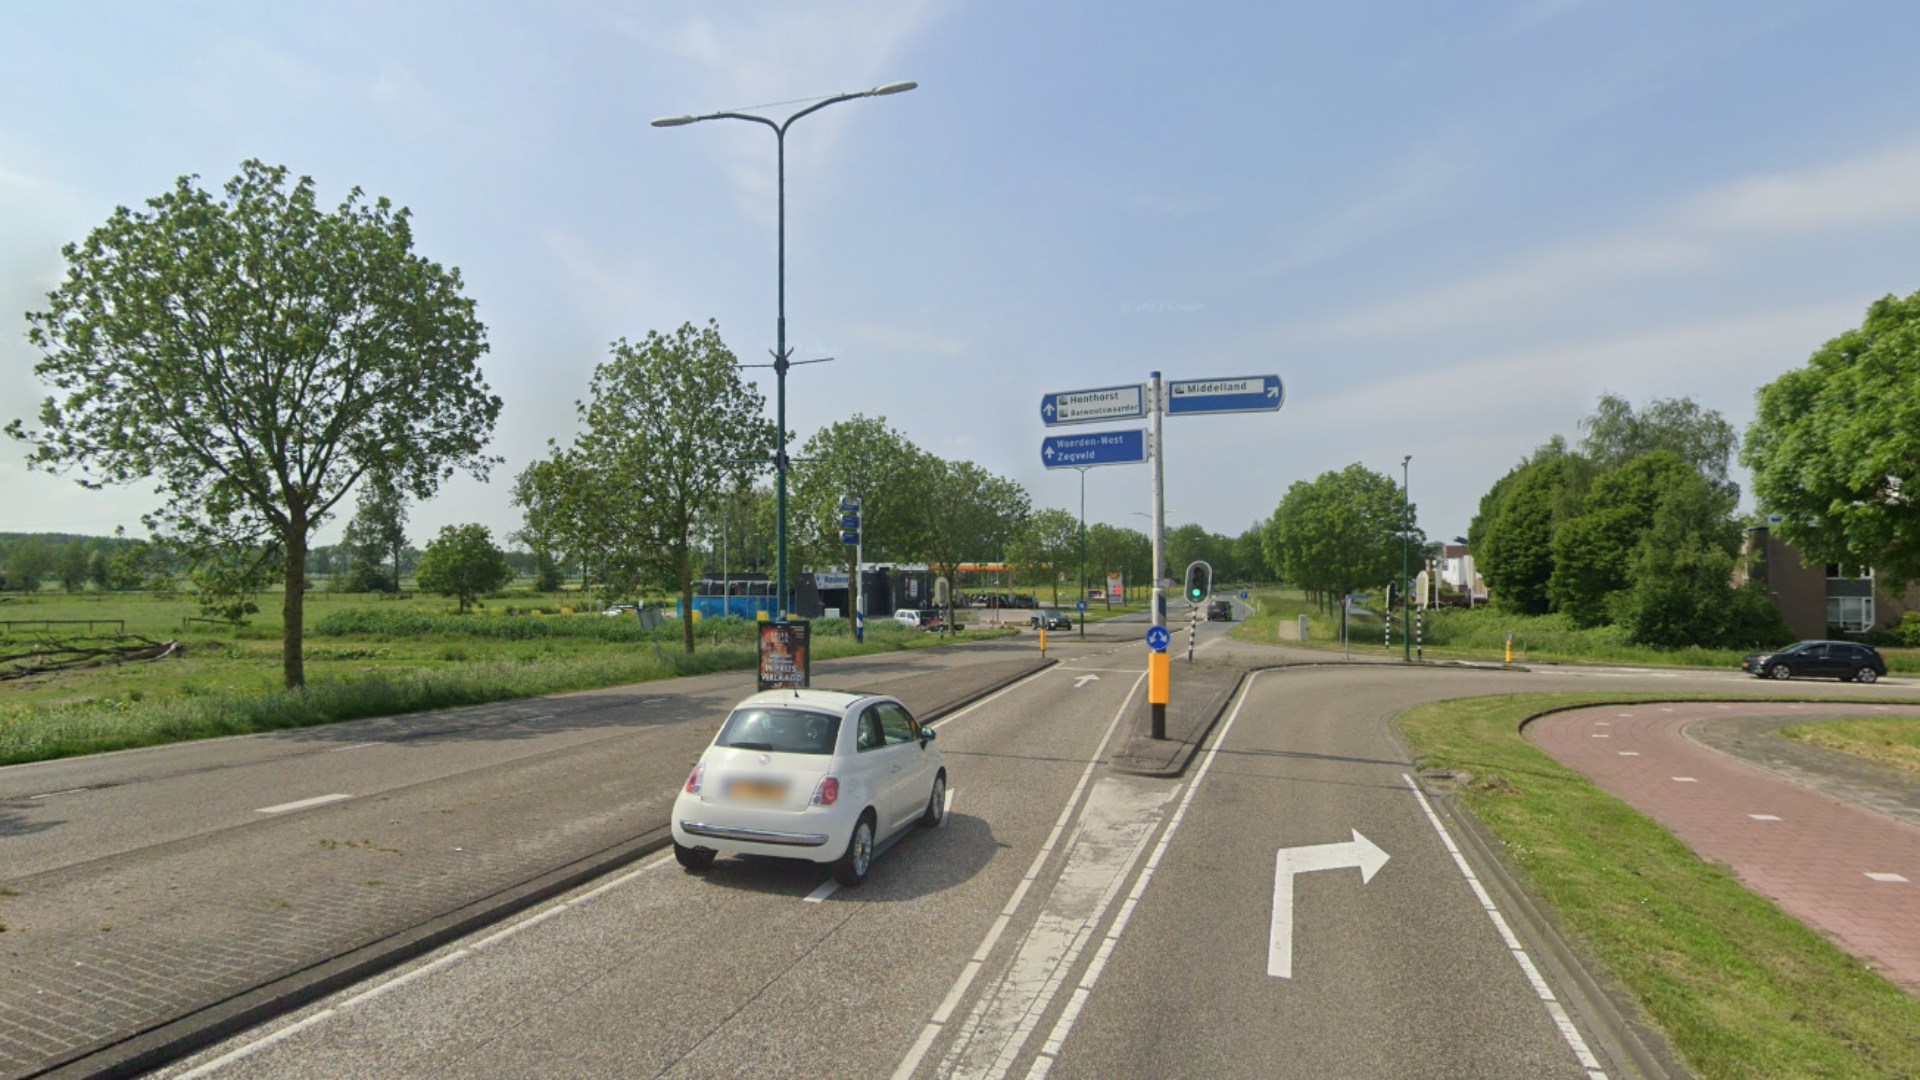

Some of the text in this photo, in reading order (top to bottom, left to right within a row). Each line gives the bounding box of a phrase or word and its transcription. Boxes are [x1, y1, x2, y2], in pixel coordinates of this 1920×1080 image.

[1187, 382, 1247, 395] Middelland
[1070, 393, 1119, 404] Honthorst
[1057, 436, 1123, 448] Woerden-West
[1057, 451, 1095, 462] Zegveld
[762, 673, 802, 681] VERLAAGD
